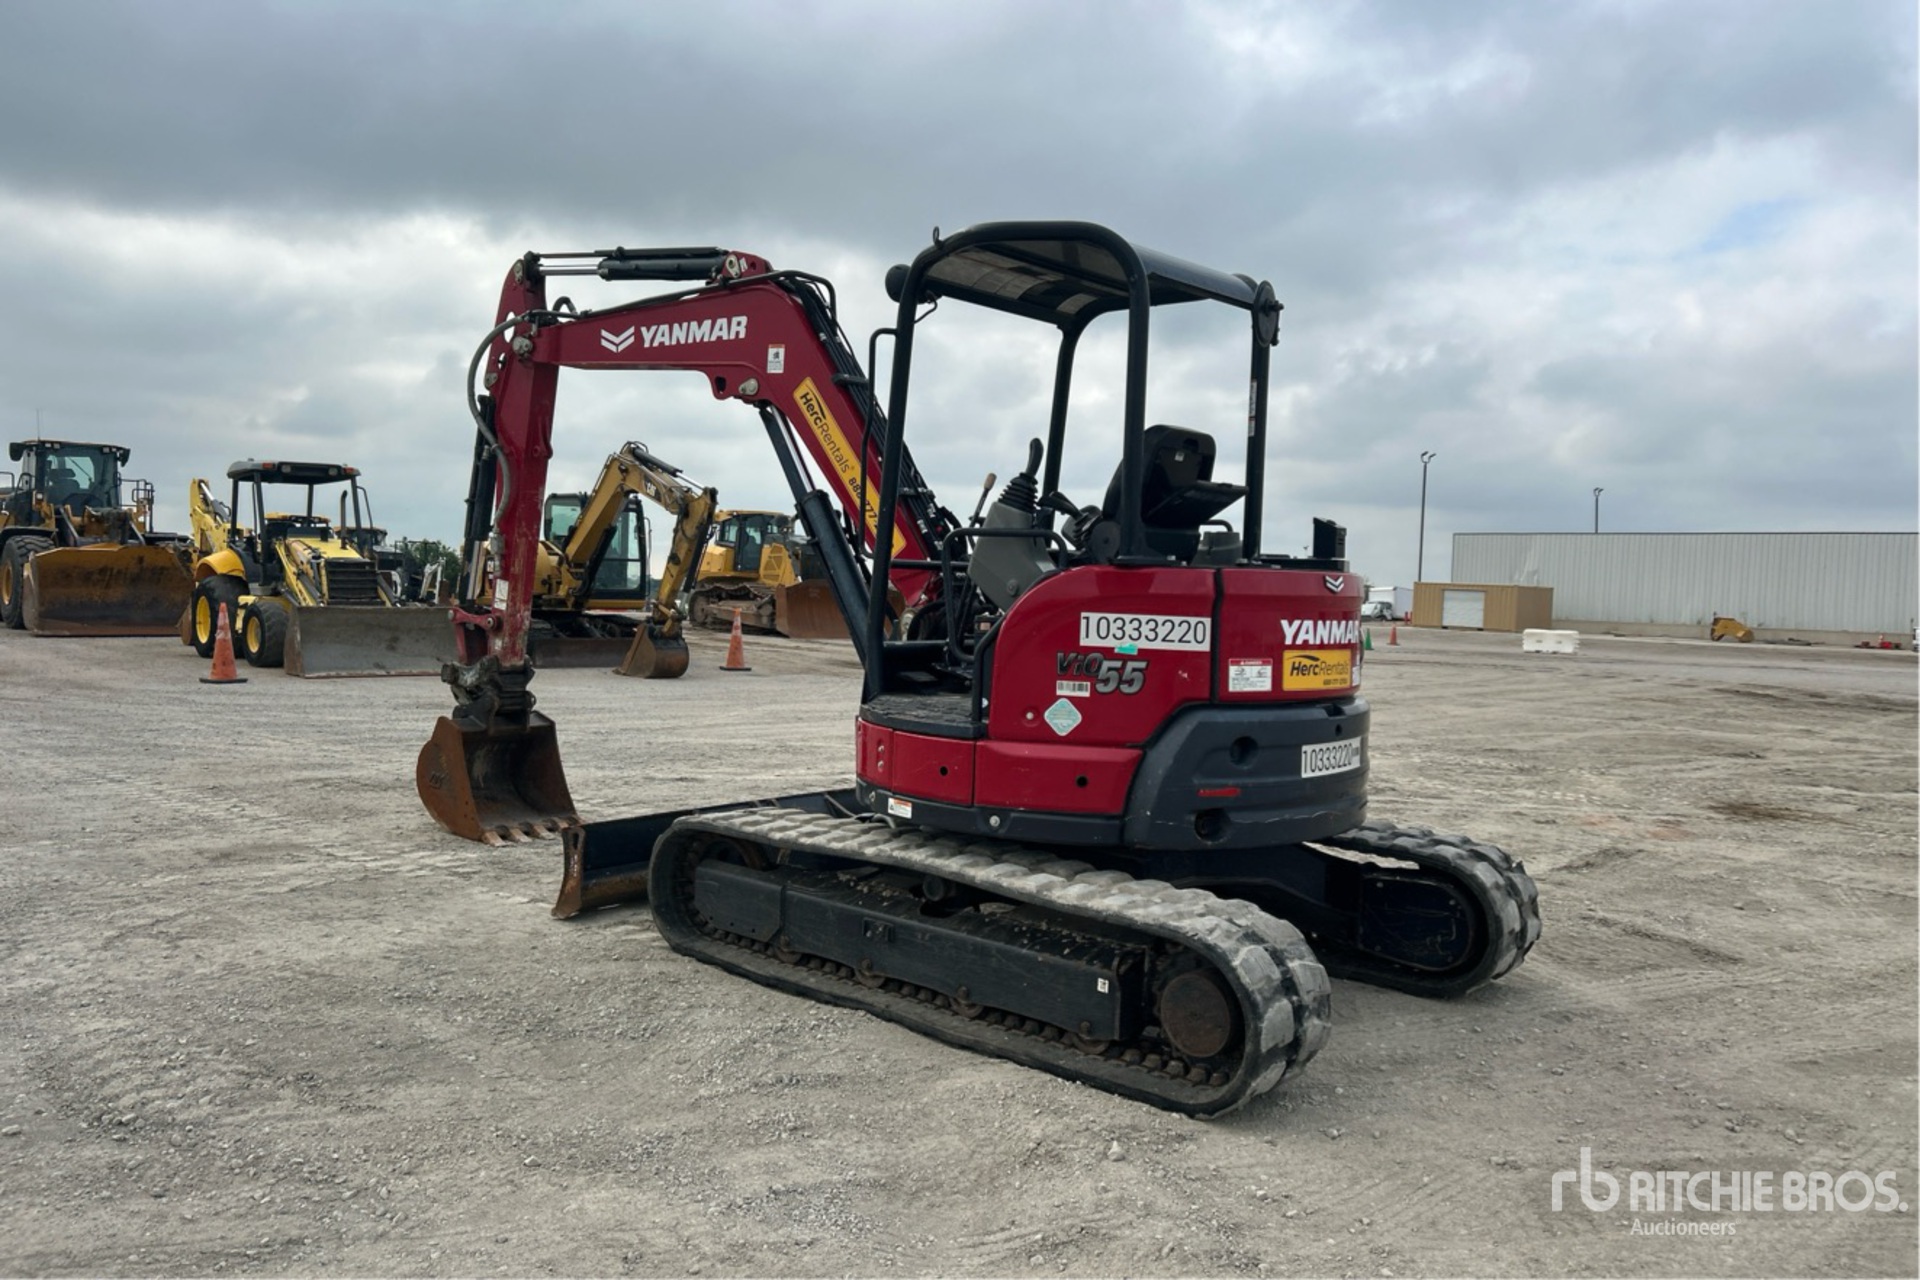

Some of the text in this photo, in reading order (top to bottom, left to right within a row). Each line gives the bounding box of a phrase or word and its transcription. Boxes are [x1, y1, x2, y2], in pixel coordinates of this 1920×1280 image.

[640, 315, 748, 348] YANMAR
[800, 391, 850, 474] HercRentals
[1082, 616, 1206, 644] 10333220
[1290, 660, 1348, 677] HercRentals
[1302, 743, 1352, 774] 10333220
